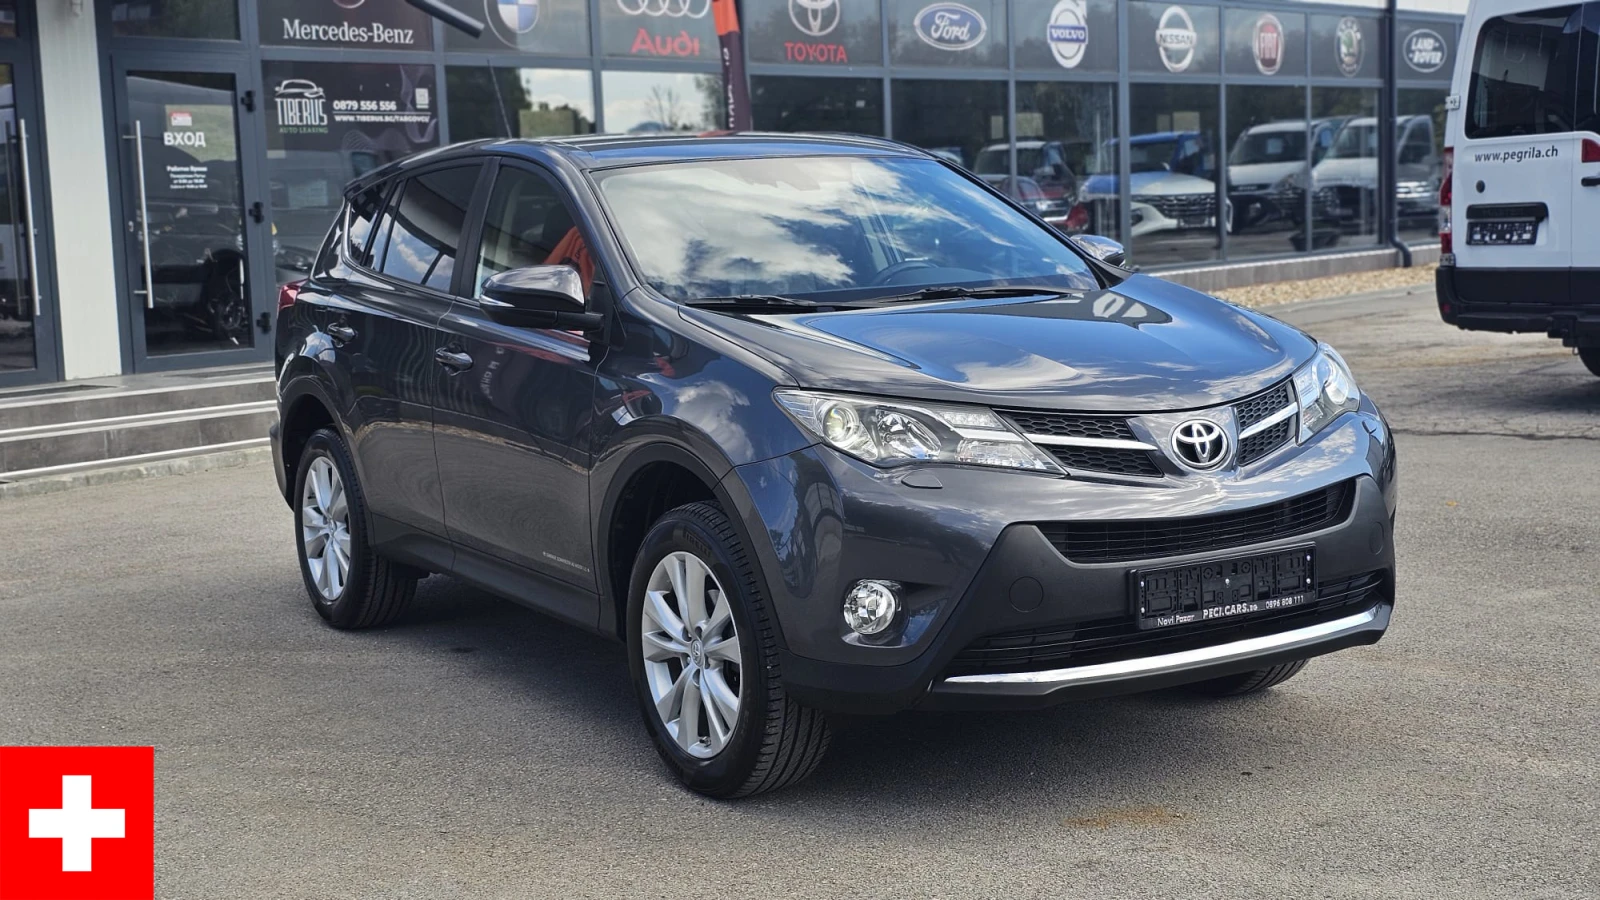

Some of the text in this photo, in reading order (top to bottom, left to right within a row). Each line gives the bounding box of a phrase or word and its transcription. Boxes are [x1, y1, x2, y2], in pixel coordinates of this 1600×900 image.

[282, 18, 414, 44] Mercedes-Benz
[930, 11, 971, 41] Ford
[1051, 28, 1086, 40] VOLVO
[630, 28, 700, 56] Audi
[1159, 33, 1194, 46] NISSAN
[1259, 32, 1278, 59] FIAT
[1411, 37, 1435, 50] LAND
[784, 41, 848, 64] TOYOTA
[1412, 50, 1443, 64] ROVER
[274, 98, 328, 126] TIBERUS
[333, 100, 397, 111] 0879 556 556
[163, 131, 206, 147] ВХОД
[1474, 145, 1559, 163] www.pegrila.ch
[1157, 616, 1174, 627] Novi
[1175, 614, 1195, 624] Pazar
[1265, 599, 1280, 609] 0896
[1281, 597, 1293, 606] 808
[1294, 595, 1304, 604] 111
